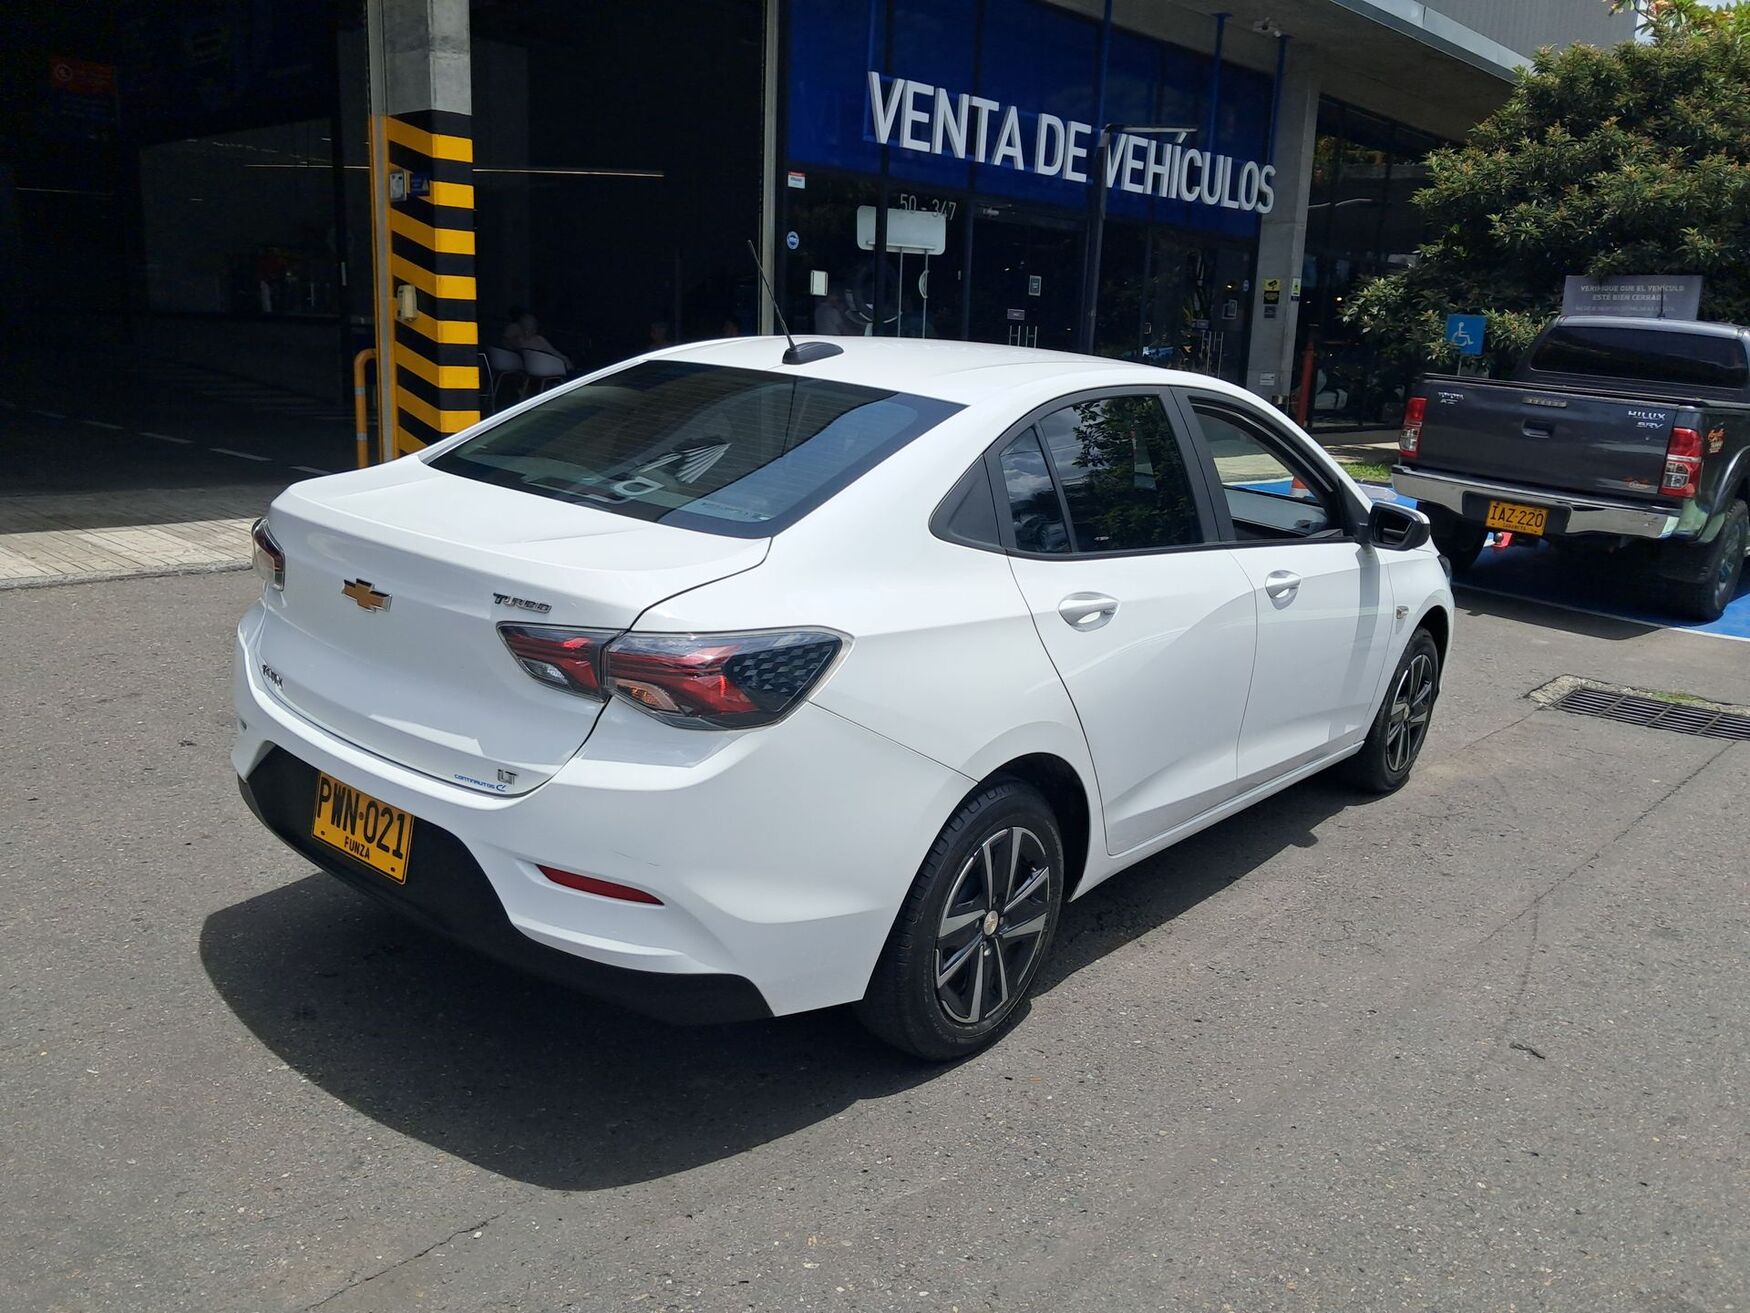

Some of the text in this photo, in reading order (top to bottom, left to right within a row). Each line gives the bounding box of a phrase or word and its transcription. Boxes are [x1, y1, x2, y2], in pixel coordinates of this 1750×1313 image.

[868, 71, 1277, 214] VENTA DE VEHÍCULOS
[1628, 410, 1666, 421] HILUX
[493, 592, 552, 614] TURBO
[497, 768, 518, 785] LT
[344, 836, 370, 861] FUNZA
